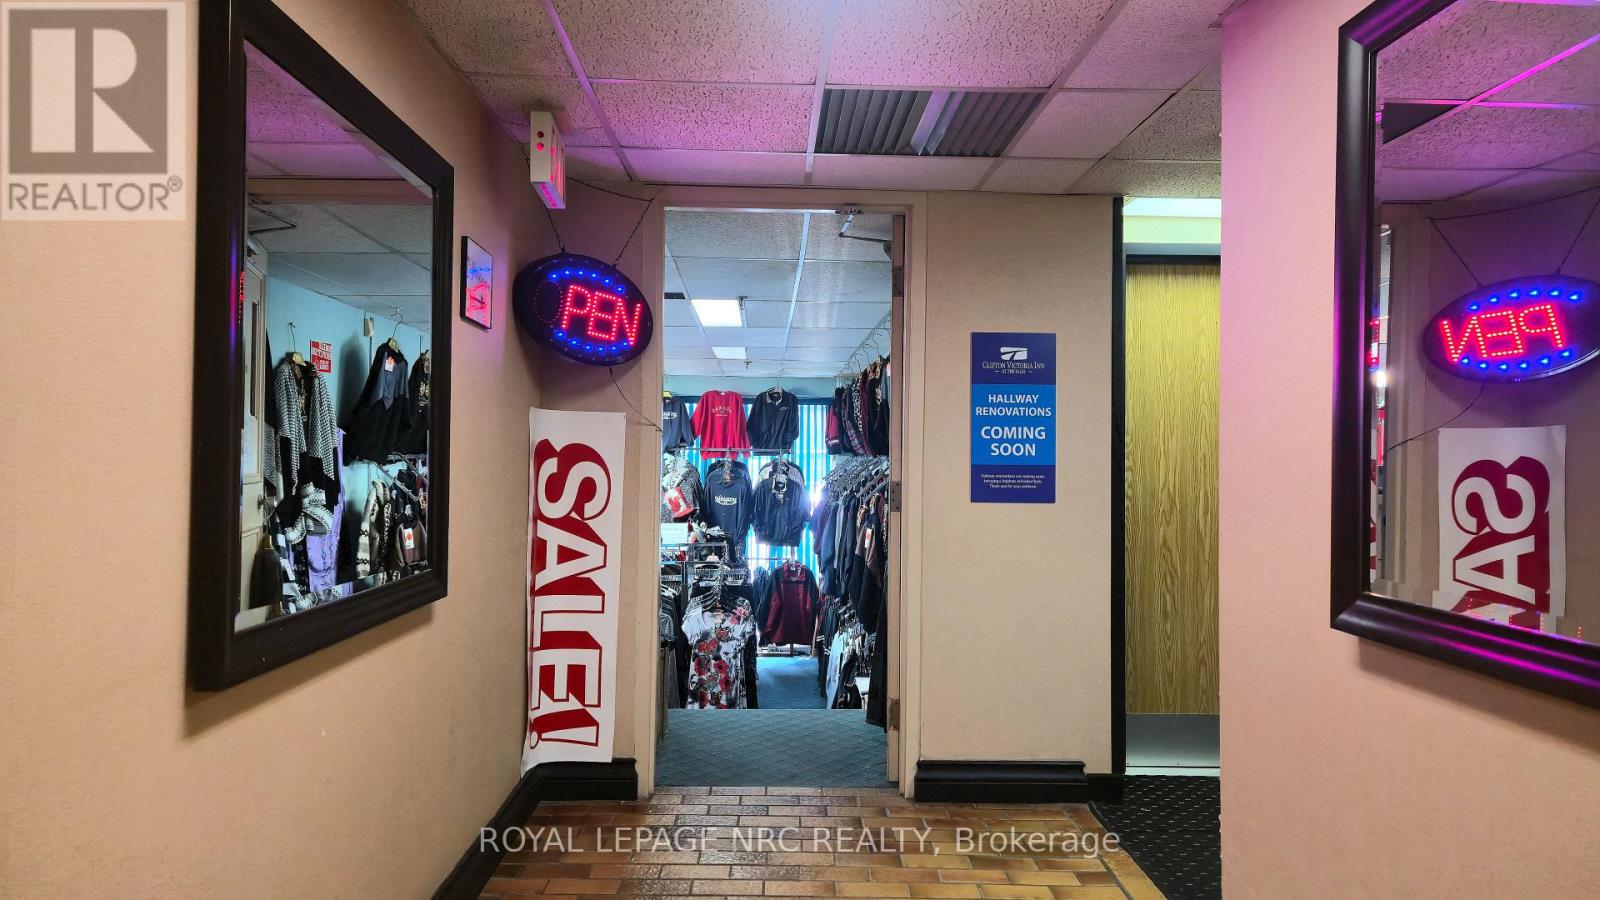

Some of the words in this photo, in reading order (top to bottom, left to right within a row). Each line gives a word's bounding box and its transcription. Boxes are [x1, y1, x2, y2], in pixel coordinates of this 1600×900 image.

[988, 394, 1039, 404] HALLWAY
[975, 406, 1052, 417] RENOVATIONS
[981, 426, 1046, 440] COMING
[990, 442, 1036, 456] SOON
[530, 438, 612, 750] SALE!
